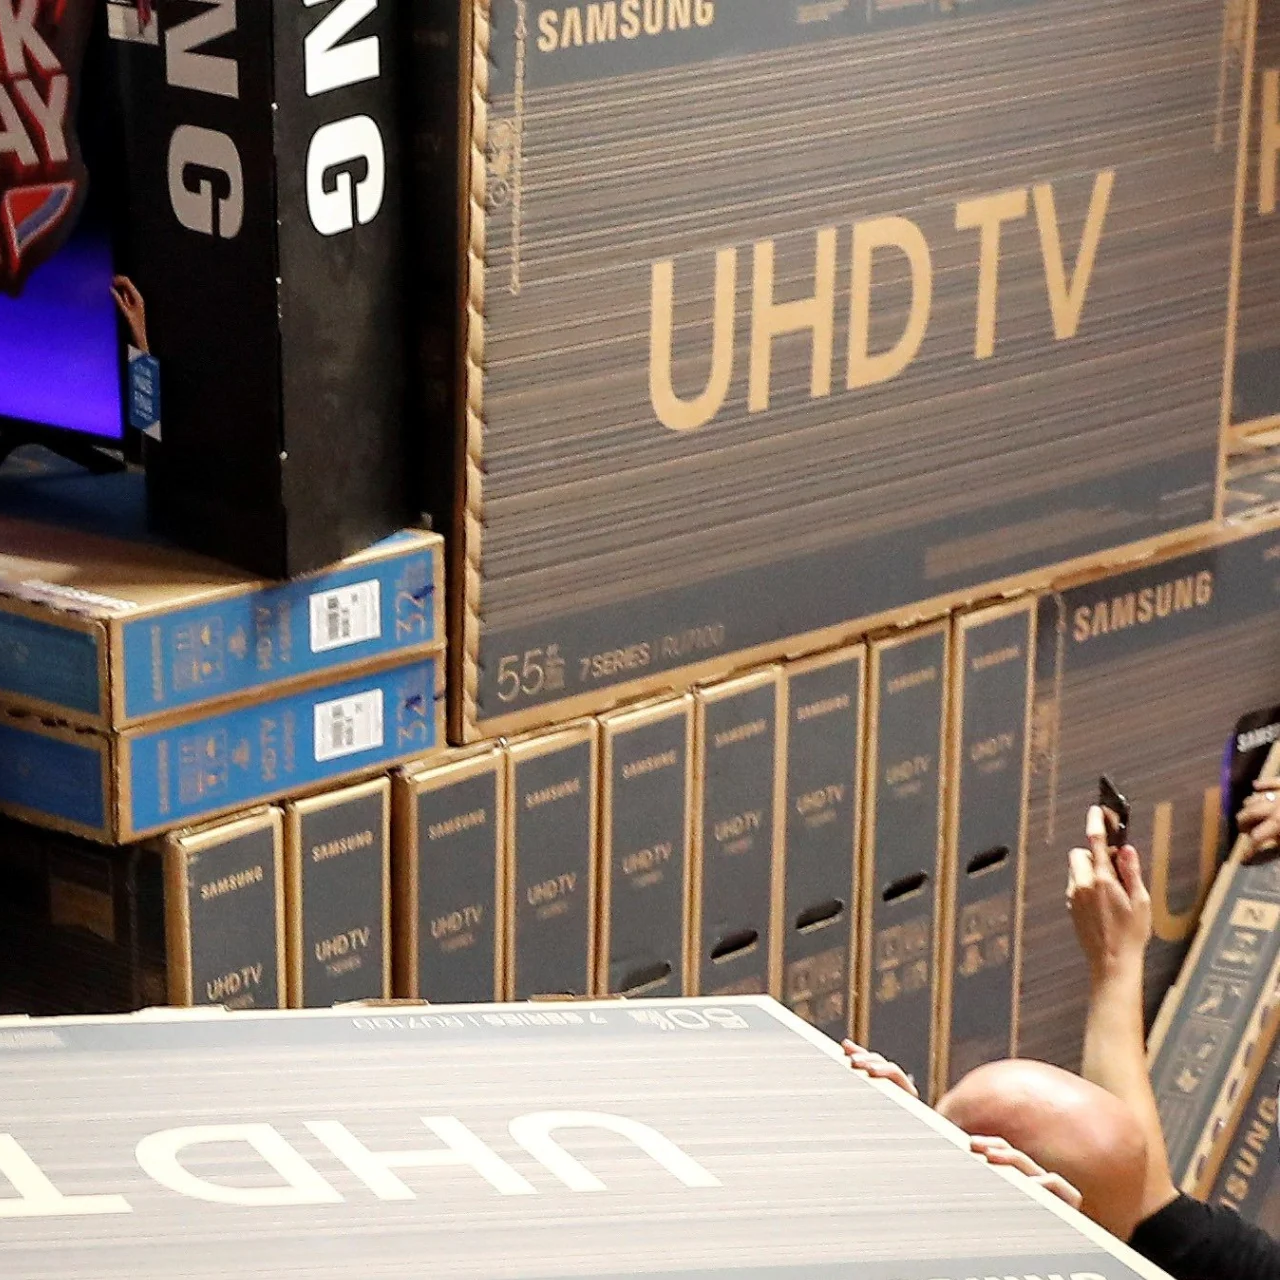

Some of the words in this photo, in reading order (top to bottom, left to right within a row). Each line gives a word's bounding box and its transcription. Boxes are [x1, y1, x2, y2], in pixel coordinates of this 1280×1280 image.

[536, 0, 715, 53] SAMSUNG
[648, 216, 933, 433] UHD
[954, 170, 1115, 361] TV
[1071, 572, 1214, 643] SAMSUNG
[526, 776, 582, 810] SAMSUNG
[311, 830, 375, 863] SAMSUNG
[427, 808, 487, 841] SAMSUNG
[200, 865, 264, 900] SAMSUNG
[135, 1110, 724, 1207] UHD
